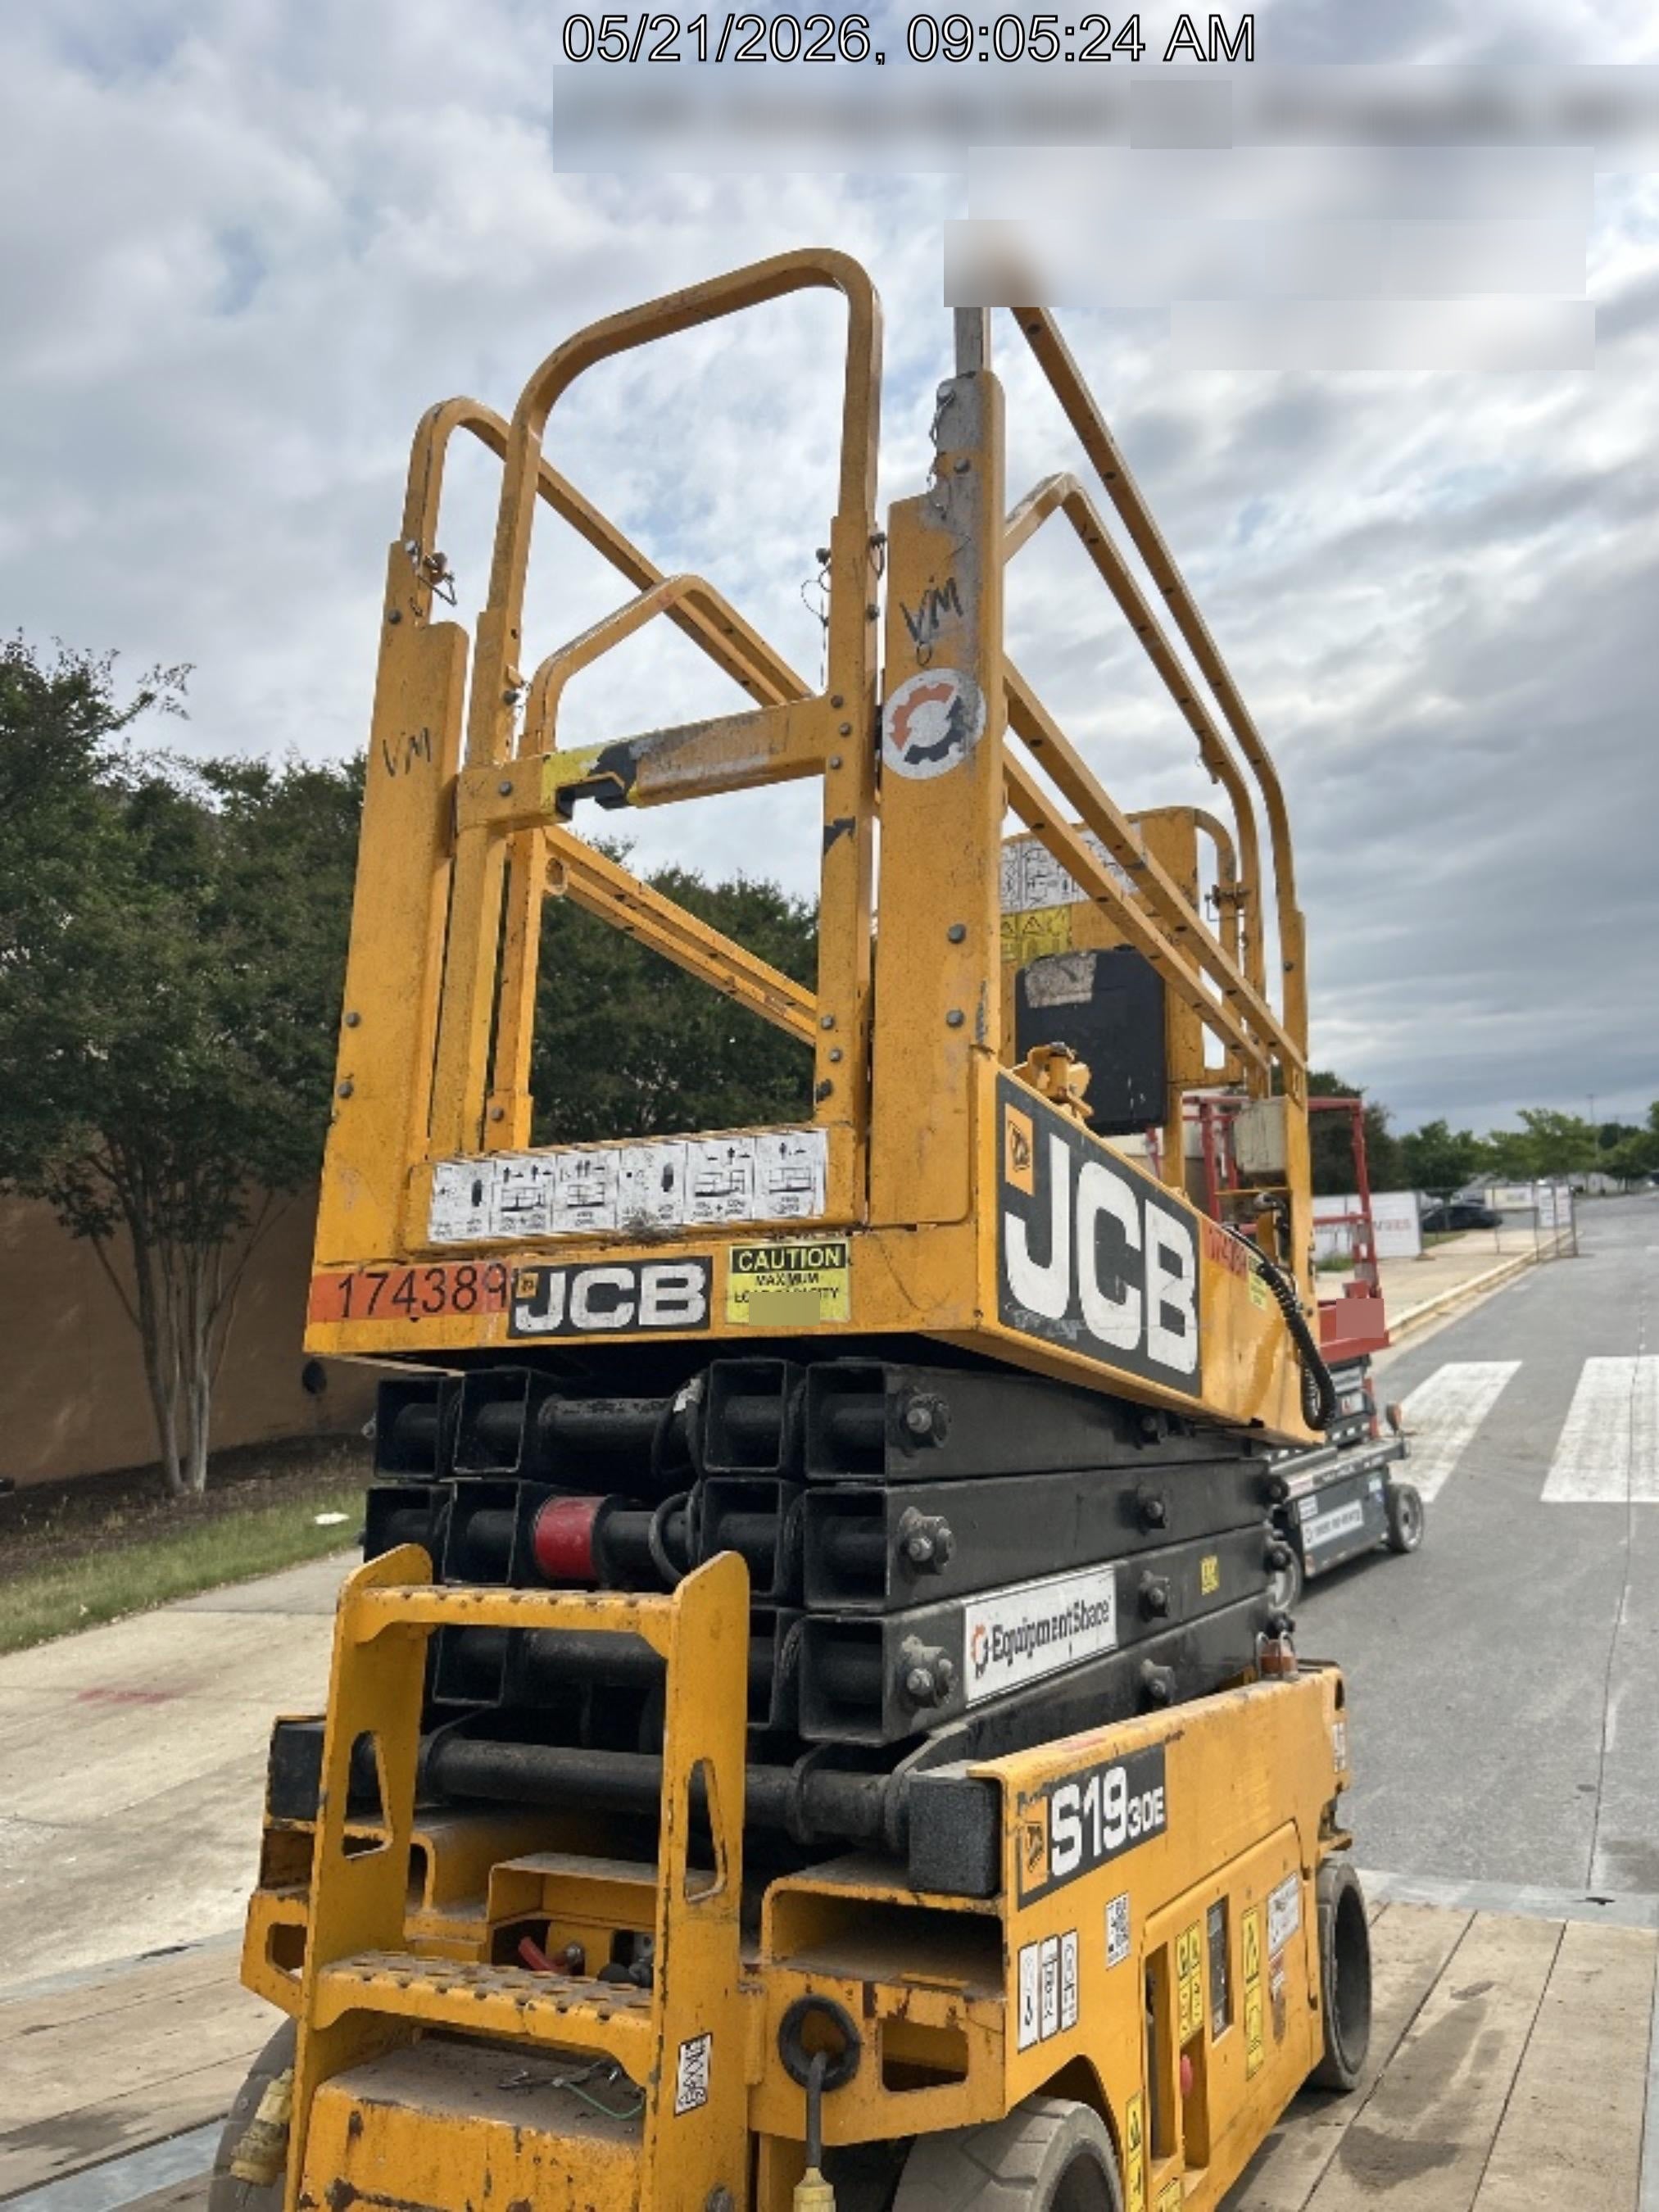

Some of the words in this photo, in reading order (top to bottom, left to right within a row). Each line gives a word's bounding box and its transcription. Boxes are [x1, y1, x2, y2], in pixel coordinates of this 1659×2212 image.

[739, 1246, 841, 1271] CAUTION
[1004, 1133, 1197, 1376] JCB
[338, 1262, 509, 1318] 174389
[515, 1264, 706, 1332] JCB
[992, 1598, 1109, 1667] EquipmentShare
